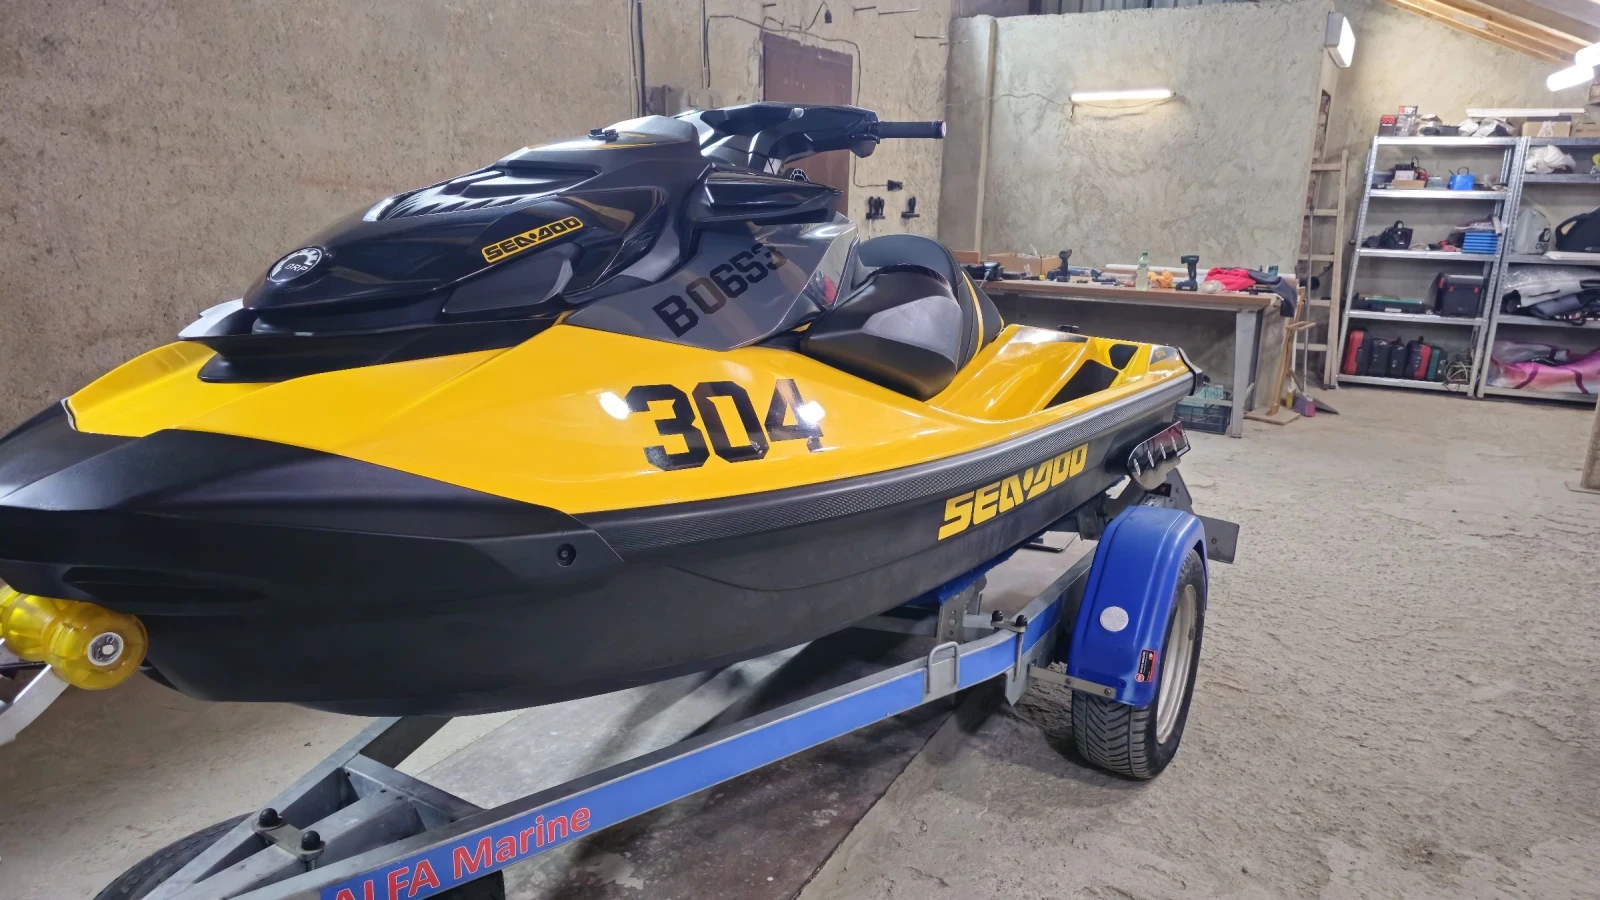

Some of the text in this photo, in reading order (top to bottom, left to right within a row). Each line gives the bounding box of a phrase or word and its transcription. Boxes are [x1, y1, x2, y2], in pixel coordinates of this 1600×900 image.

[285, 263, 309, 272] BRP
[624, 378, 825, 472] 304
[452, 807, 591, 880] Marine
